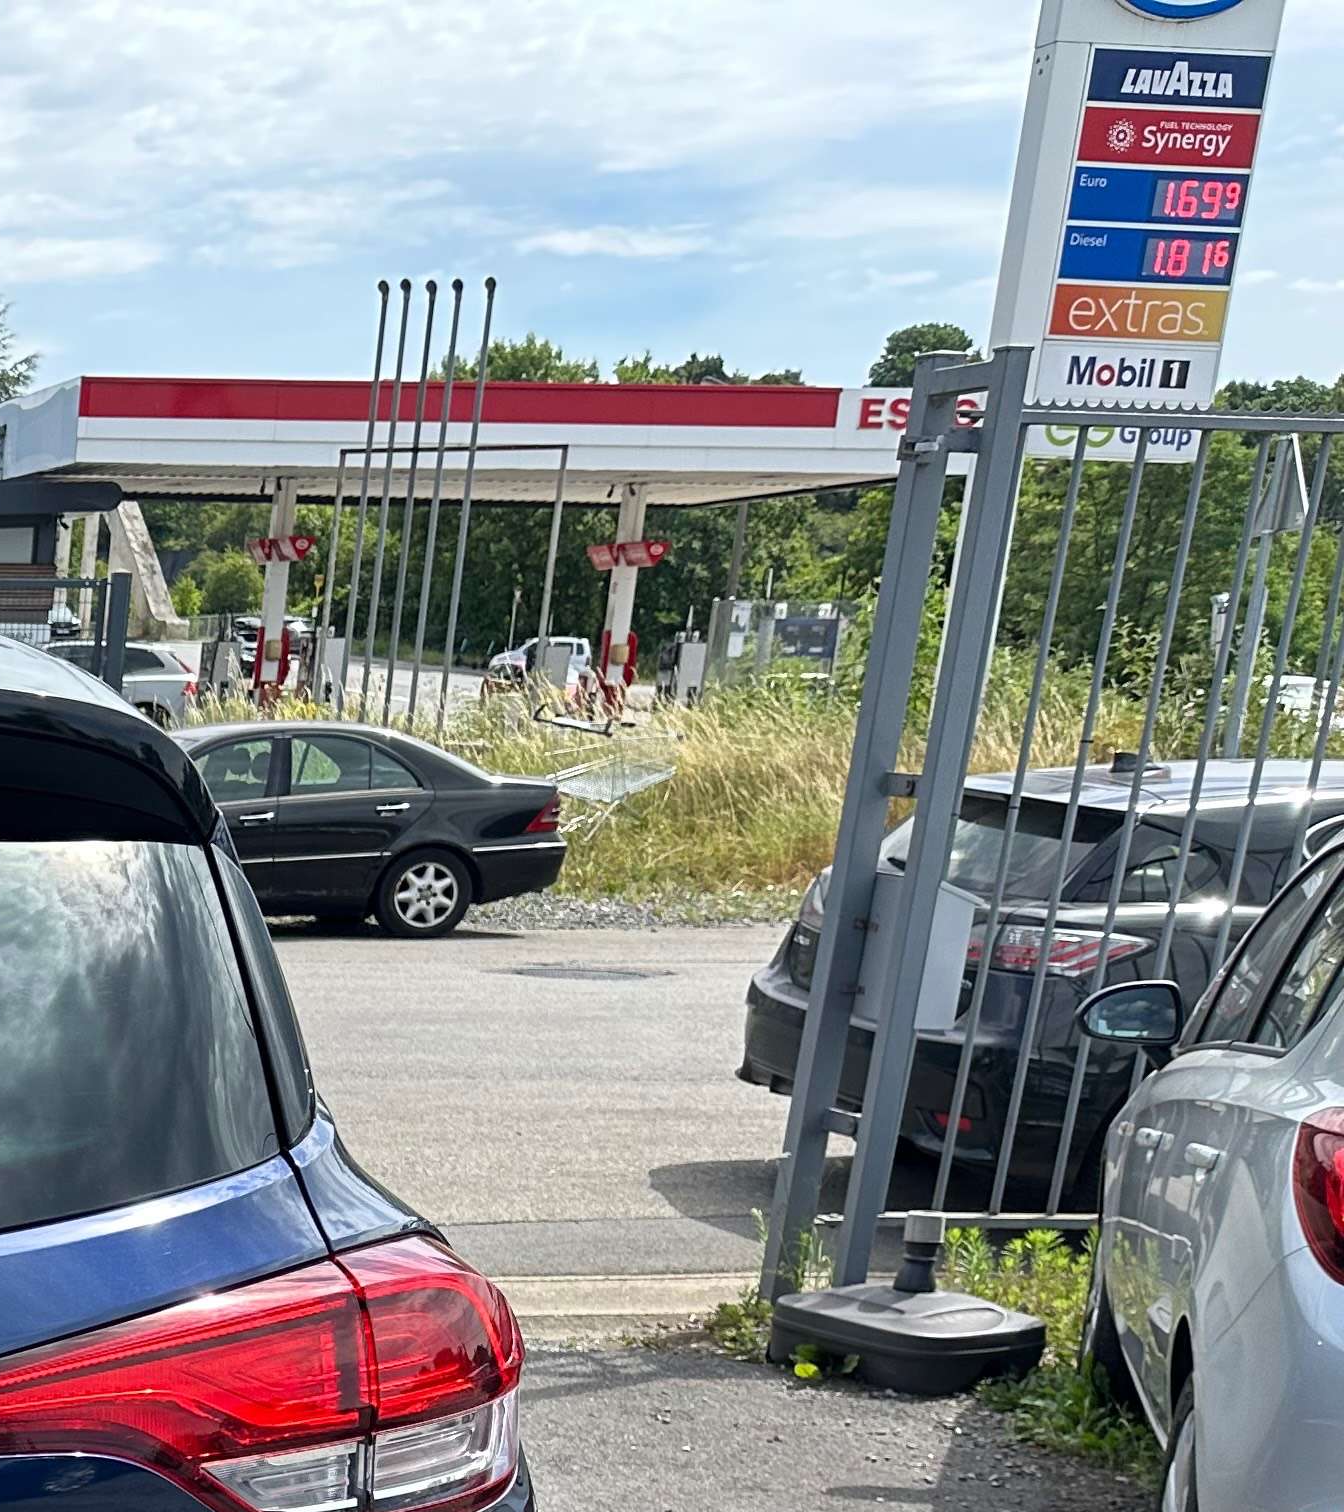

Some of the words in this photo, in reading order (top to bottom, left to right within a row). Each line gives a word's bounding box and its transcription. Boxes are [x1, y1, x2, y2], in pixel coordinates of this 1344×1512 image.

[1120, 61, 1233, 99] LAVAZZA
[1159, 121, 1179, 130] FUEL
[1181, 121, 1233, 132] TECHNOLOGY
[1141, 126, 1231, 158] Synergy
[1079, 173, 1107, 188] Euro
[1069, 232, 1108, 247] Diesel
[1068, 290, 1206, 336] extras
[1066, 355, 1156, 388] Mobil
[1119, 426, 1192, 451] Goup
